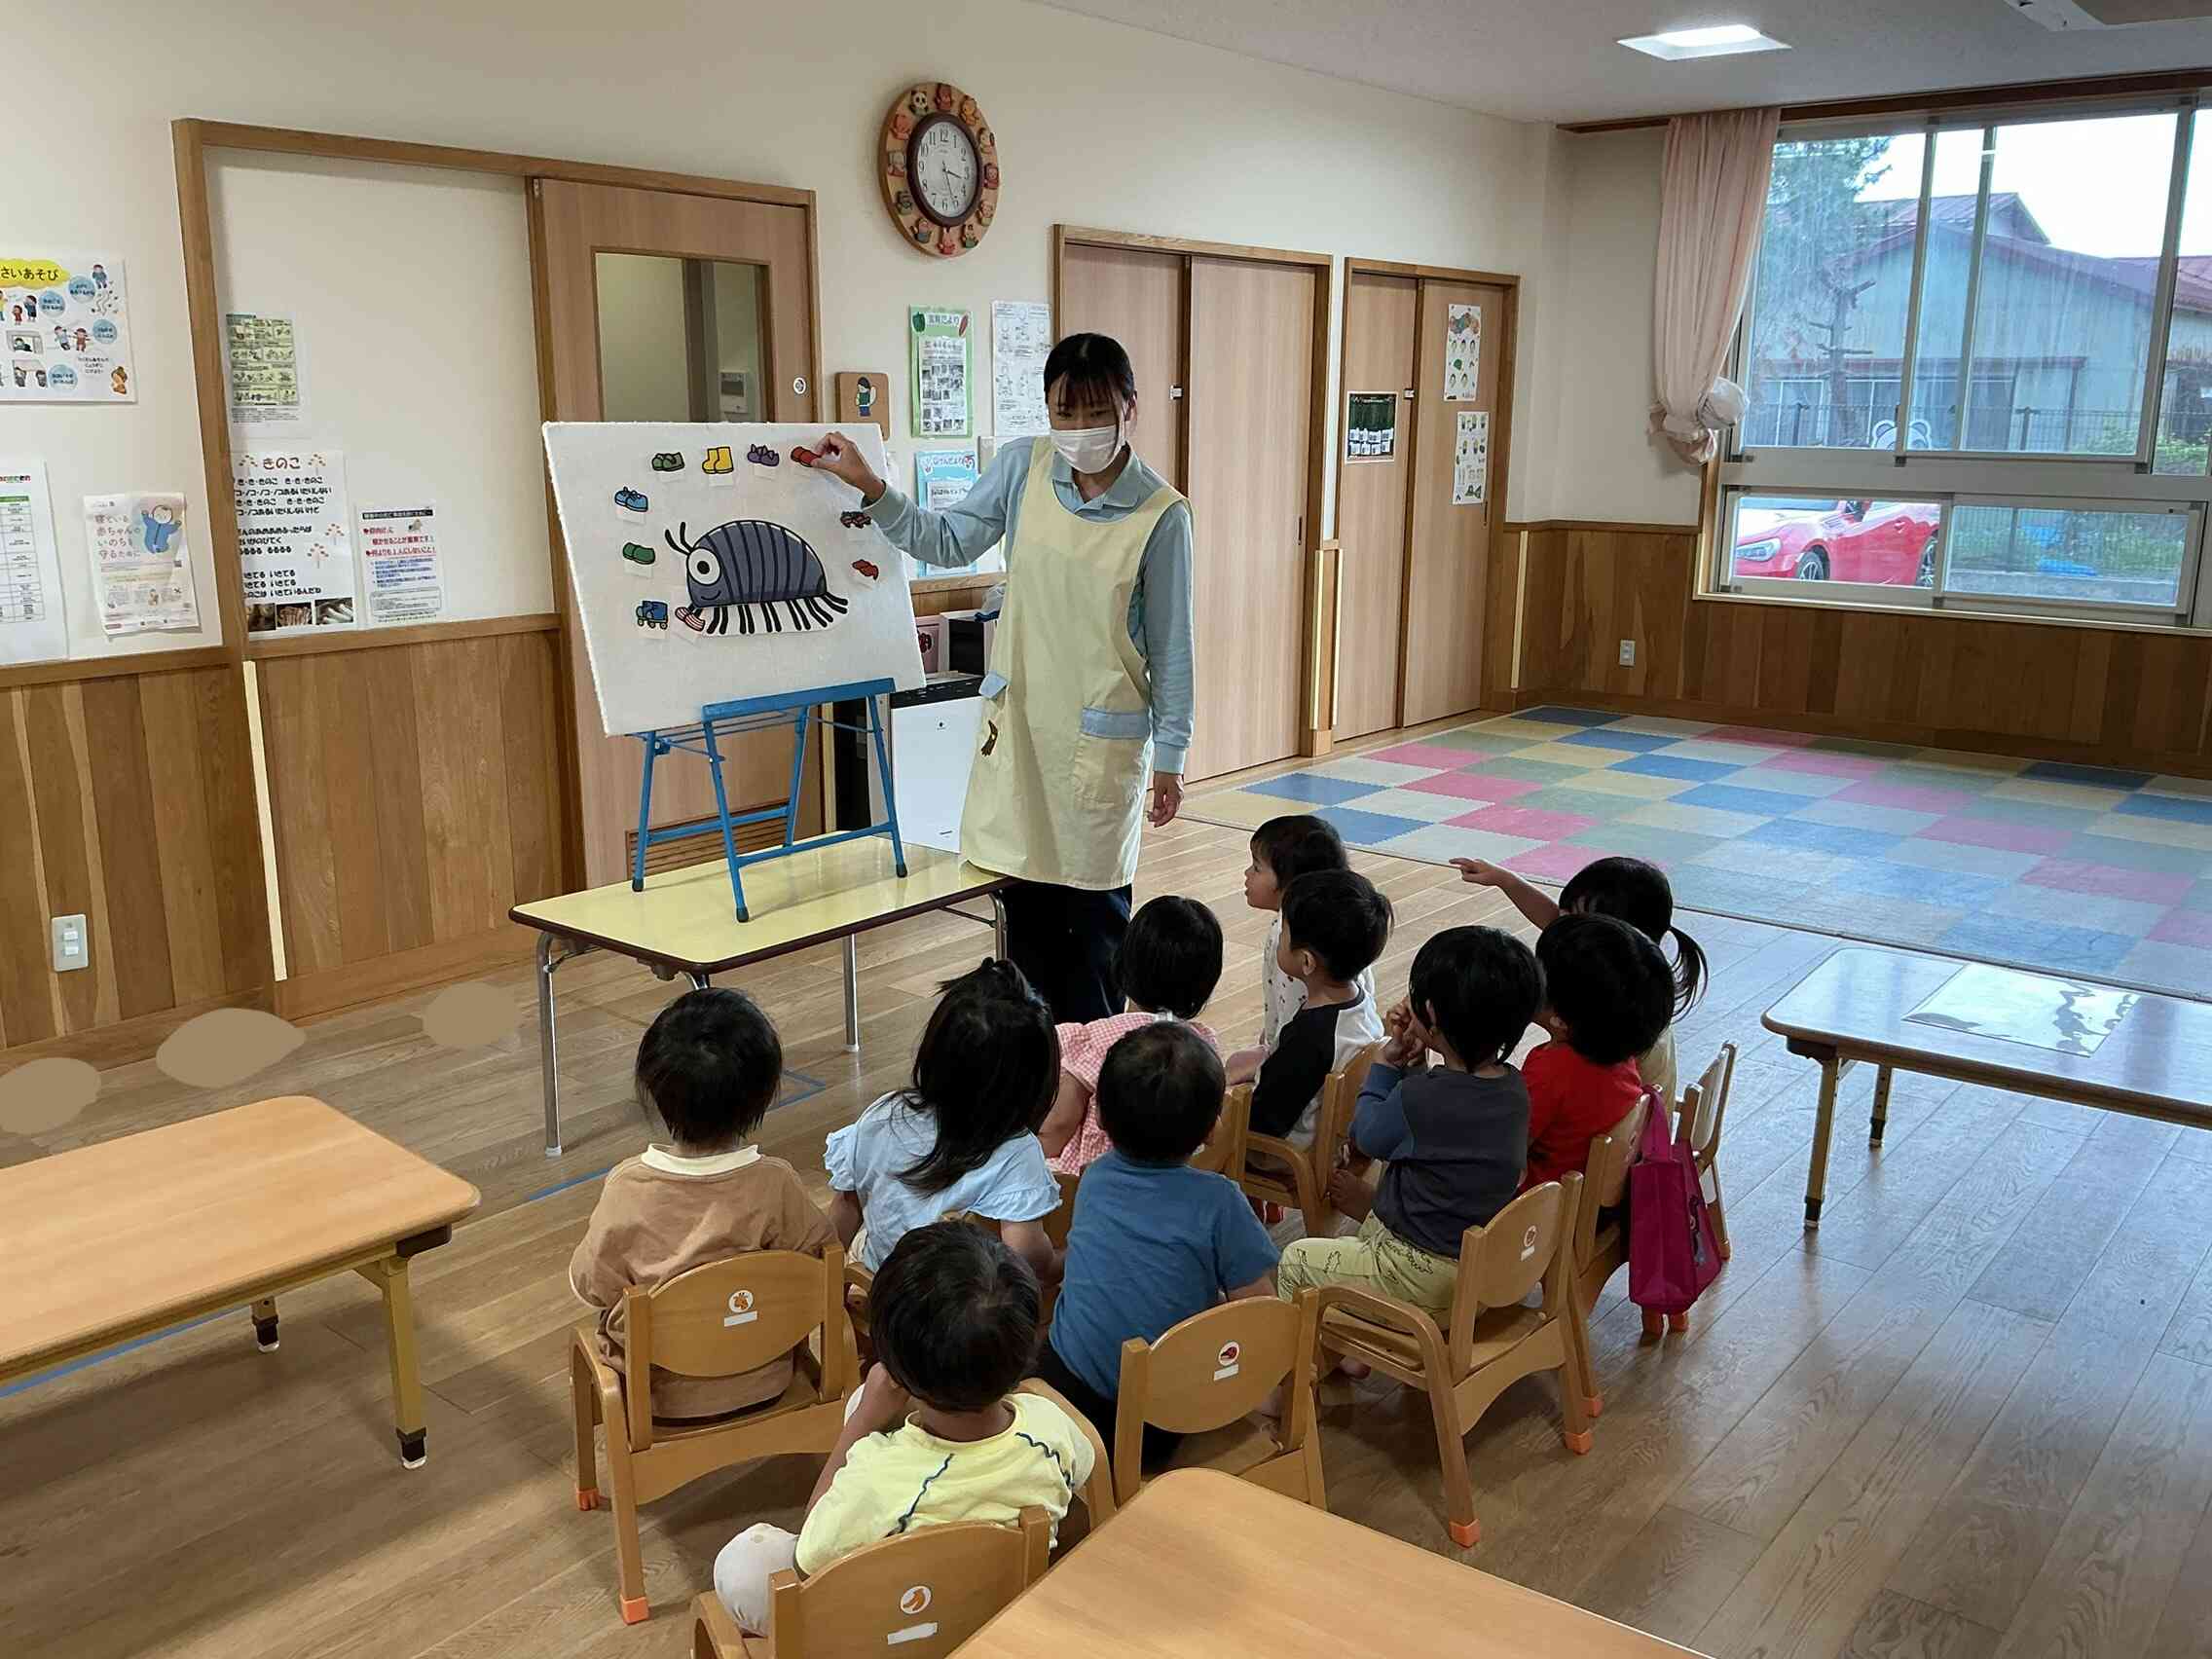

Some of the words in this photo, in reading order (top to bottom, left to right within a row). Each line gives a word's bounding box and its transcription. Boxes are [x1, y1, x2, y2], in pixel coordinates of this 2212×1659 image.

[929, 131, 936, 146] 11
[940, 128, 949, 143] 12
[953, 134, 957, 149] 1
[920, 143, 929, 157] 10
[960, 147, 967, 162] 2
[918, 161, 925, 172] 9
[964, 166, 970, 180] 3
[922, 179, 928, 192] 8
[960, 184, 967, 197] 4
[931, 193, 937, 206] 7
[941, 198, 948, 211] 6
[0, 268, 58, 281] さいあそび
[263, 458, 301, 470] きのこ
